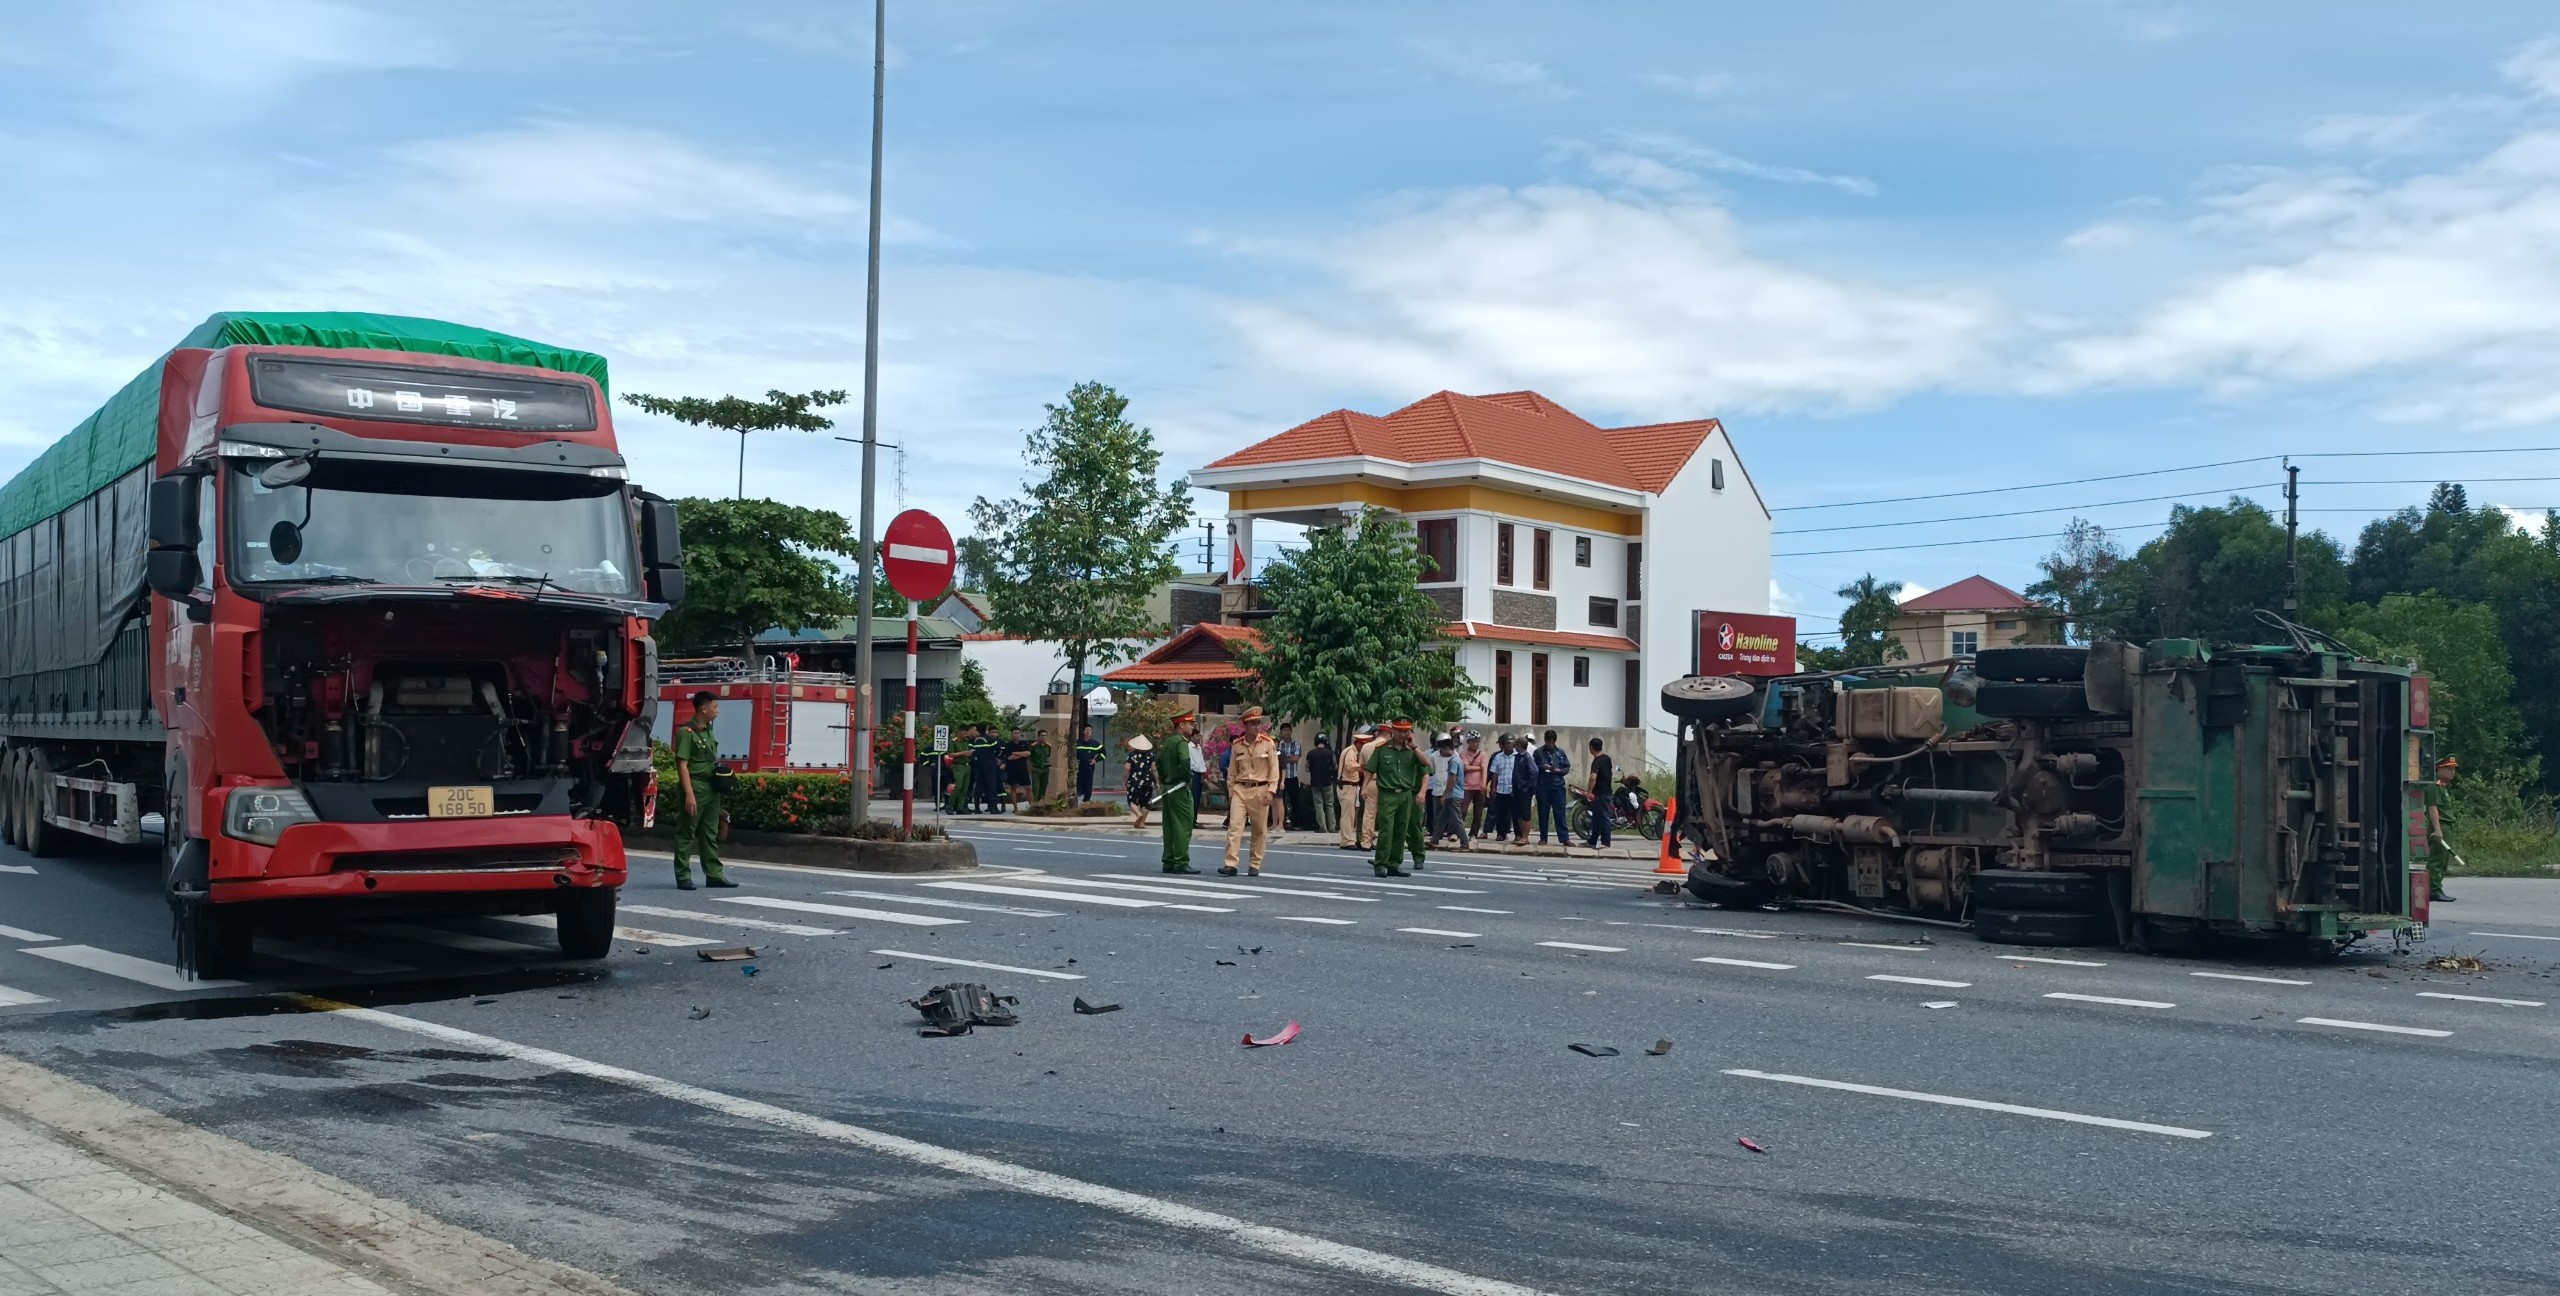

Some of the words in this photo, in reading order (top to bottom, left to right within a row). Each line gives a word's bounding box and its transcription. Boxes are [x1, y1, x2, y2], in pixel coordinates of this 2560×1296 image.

[346, 388, 518, 421] 中国重汽
[1735, 632, 1779, 652] Havoline
[447, 789, 475, 802] 20C
[438, 802, 487, 816] 168.50
